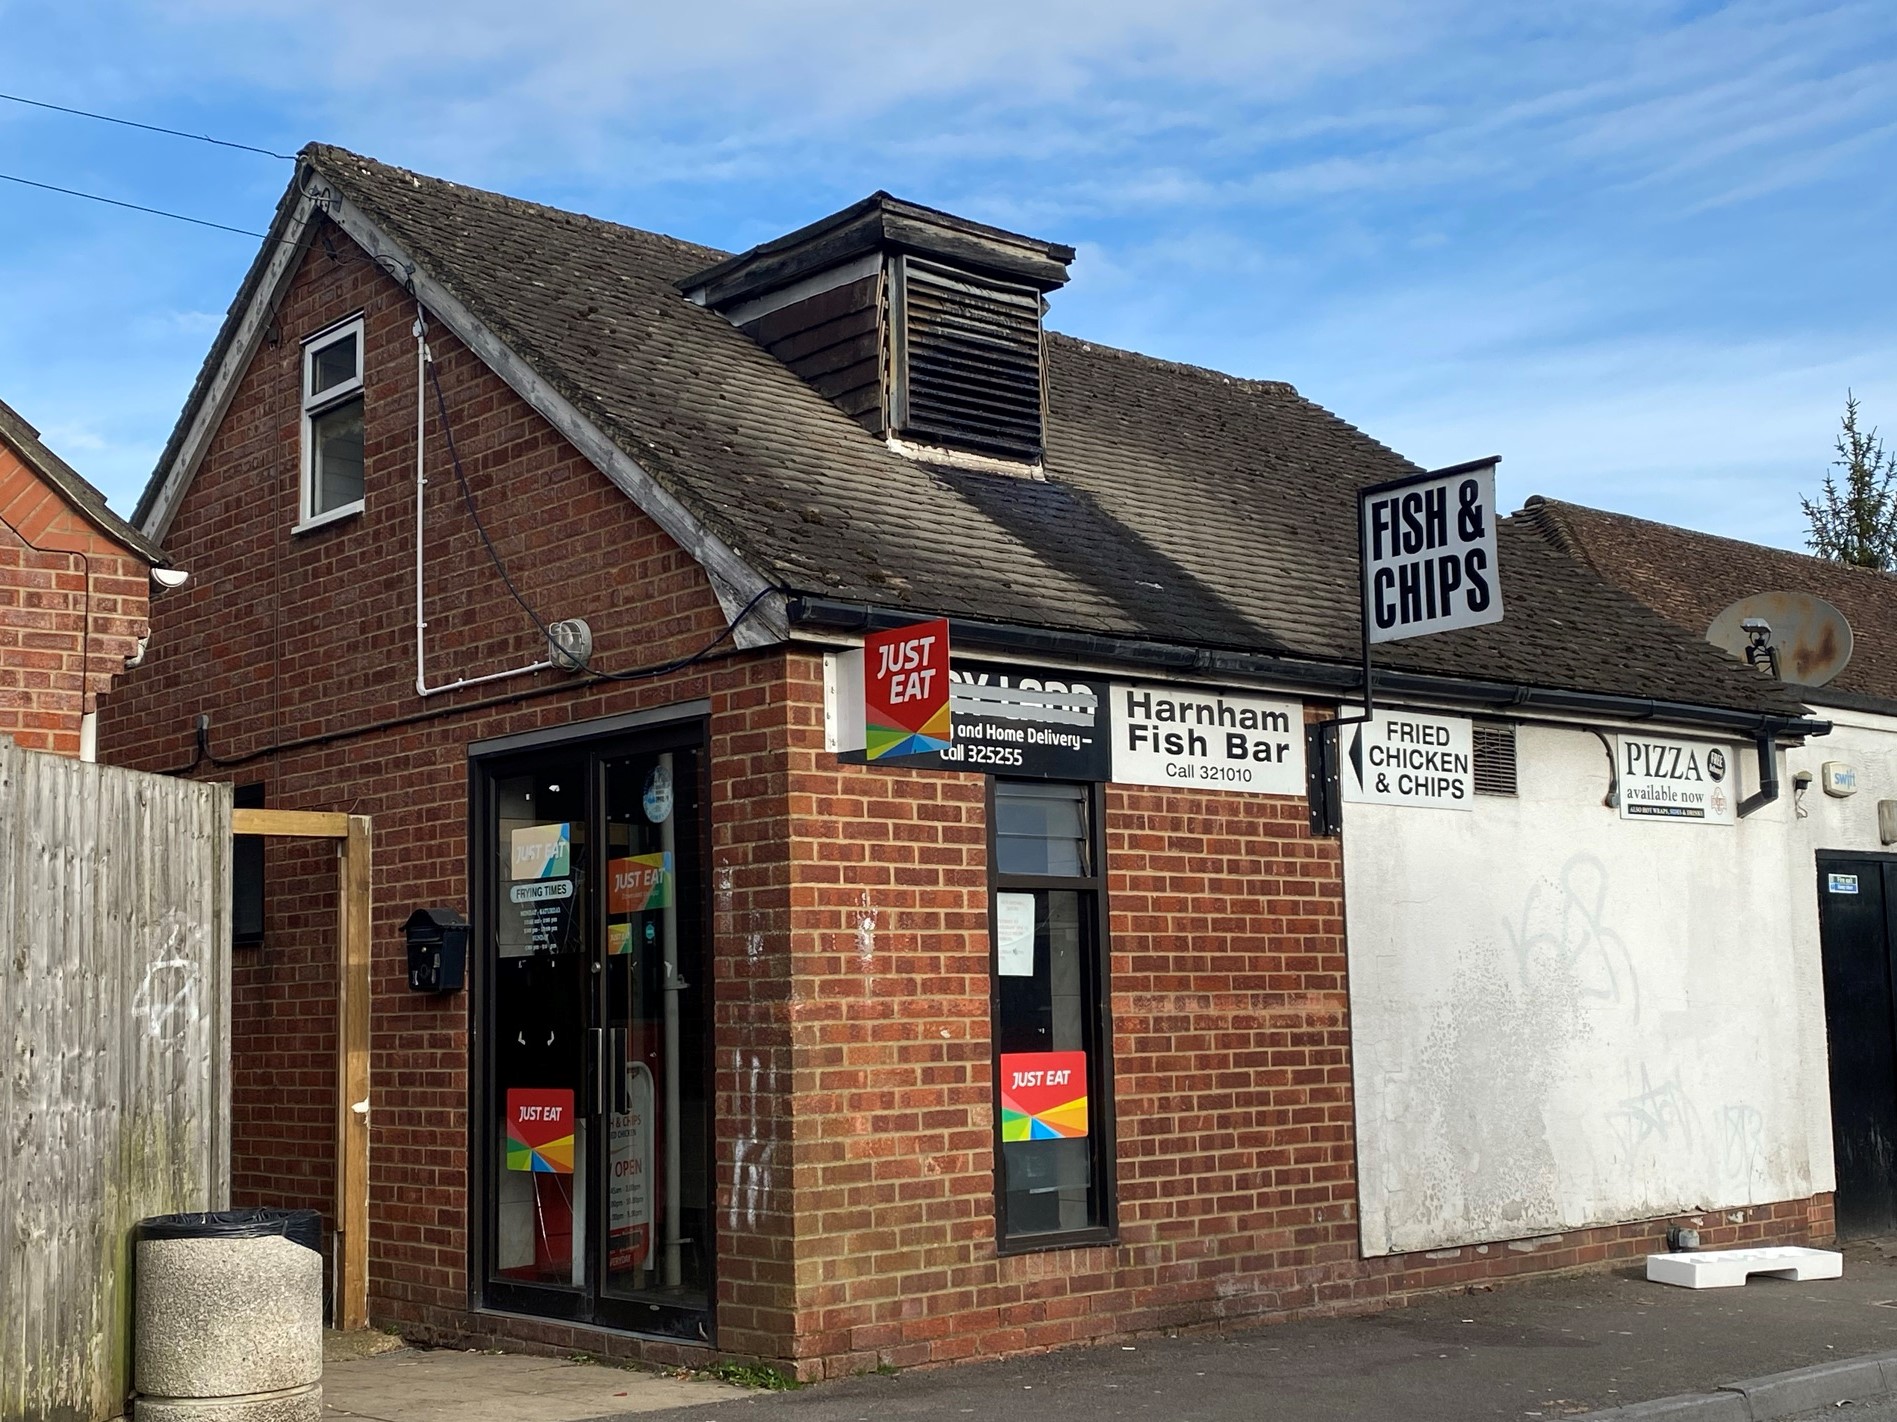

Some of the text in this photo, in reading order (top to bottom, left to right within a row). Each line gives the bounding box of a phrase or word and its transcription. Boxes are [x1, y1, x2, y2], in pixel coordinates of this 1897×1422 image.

[1372, 479, 1485, 562] FISH &
[1374, 548, 1490, 630] CHIPS
[877, 636, 936, 680] JUST
[890, 668, 936, 704] EAT
[1126, 690, 1290, 732] Harnham
[957, 723, 982, 739] and
[986, 724, 1024, 742] Home
[1128, 723, 1290, 763] Fish Bar
[1386, 720, 1450, 746] FRIED
[940, 744, 1023, 766] Call 325255
[1369, 745, 1468, 774] CHICKEN
[1624, 742, 1704, 781] PIZZA
[1166, 762, 1252, 782] Call 321010
[1834, 770, 1856, 789] swift
[1375, 772, 1464, 800] & CHIPS
[1626, 784, 1704, 803] available now
[516, 841, 566, 864] JUST EAT
[516, 884, 567, 899] FRYING TIMES
[614, 867, 666, 892] JUST EAT
[1012, 1070, 1071, 1090] JUST EAT
[519, 1106, 562, 1122] JUST EAT
[622, 1114, 641, 1126] CHIPS
[615, 1158, 642, 1177] OPEN
